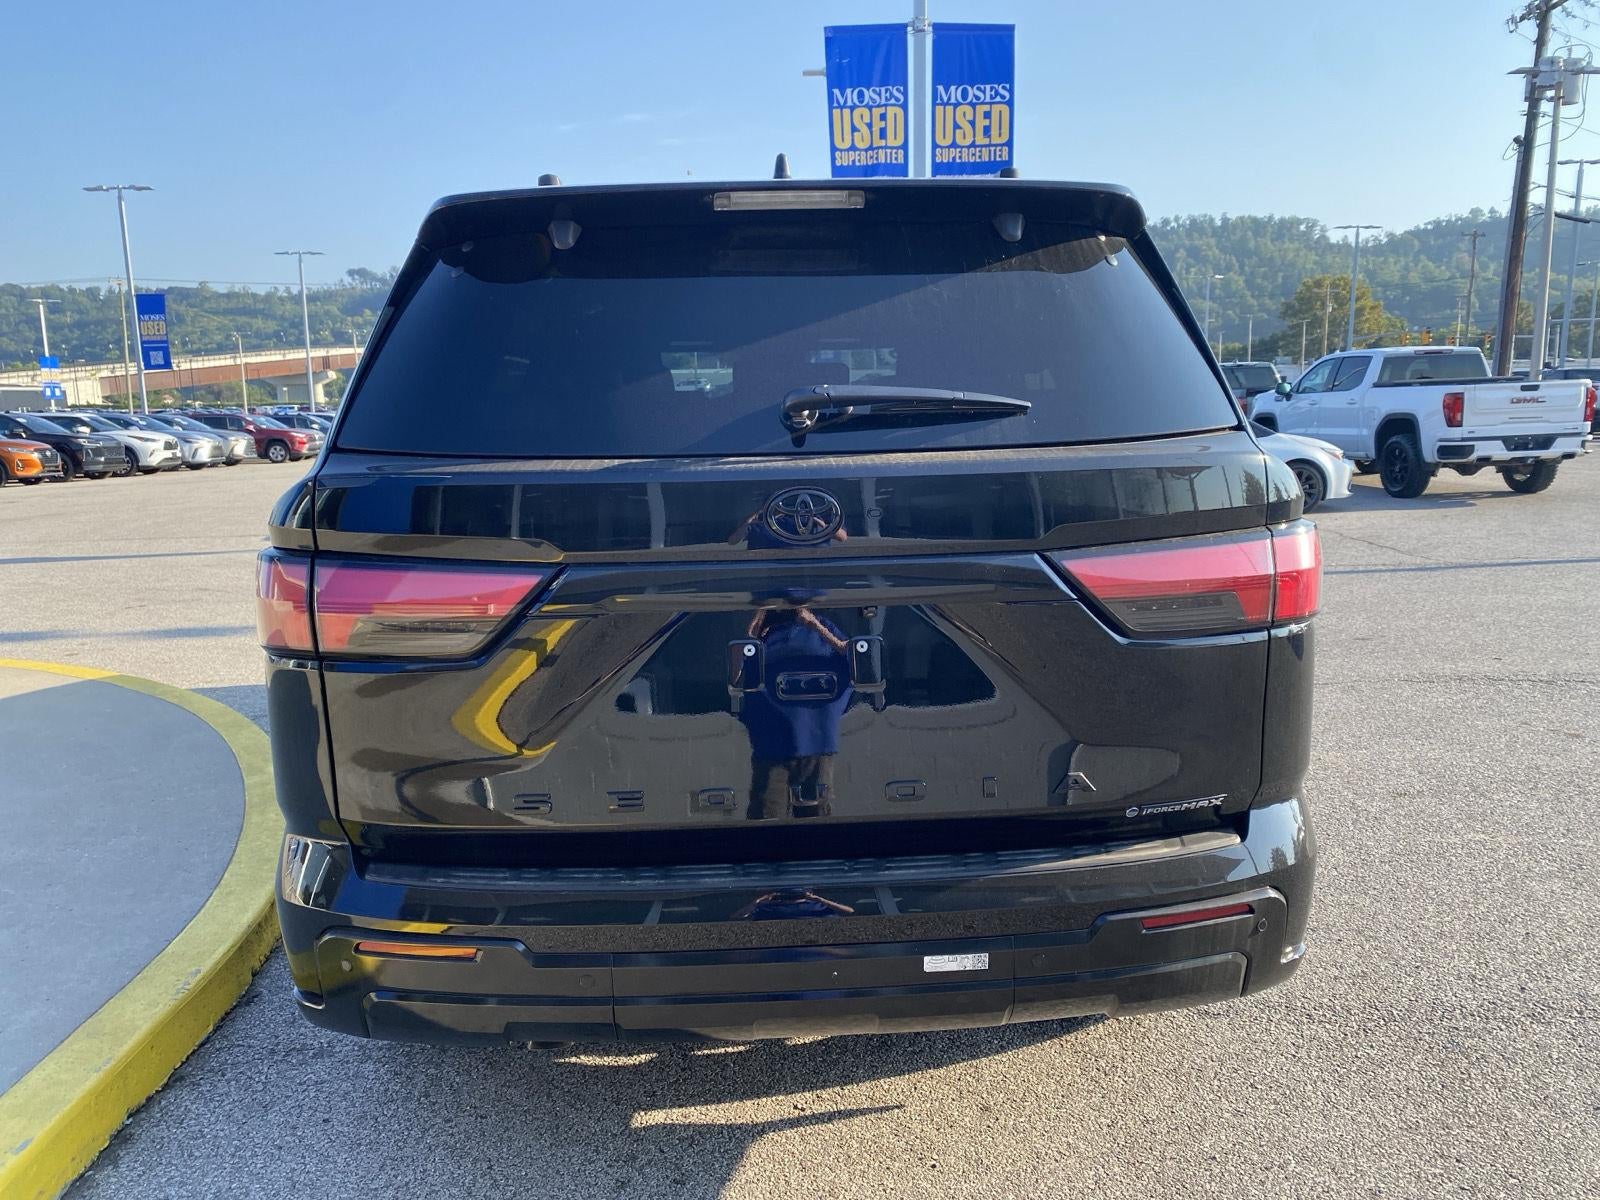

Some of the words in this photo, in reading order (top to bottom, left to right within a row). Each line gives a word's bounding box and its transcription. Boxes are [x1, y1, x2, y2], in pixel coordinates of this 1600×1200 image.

[832, 86, 904, 107] MOSES
[935, 84, 1010, 104] MOSES
[832, 106, 905, 150] USED
[935, 104, 1010, 146] USED
[835, 149, 904, 166] SUPERCENTER
[935, 147, 1009, 163] SUPERCENTER
[140, 313, 165, 321] MOSES
[140, 321, 166, 335] USED
[1511, 396, 1546, 404] GMC
